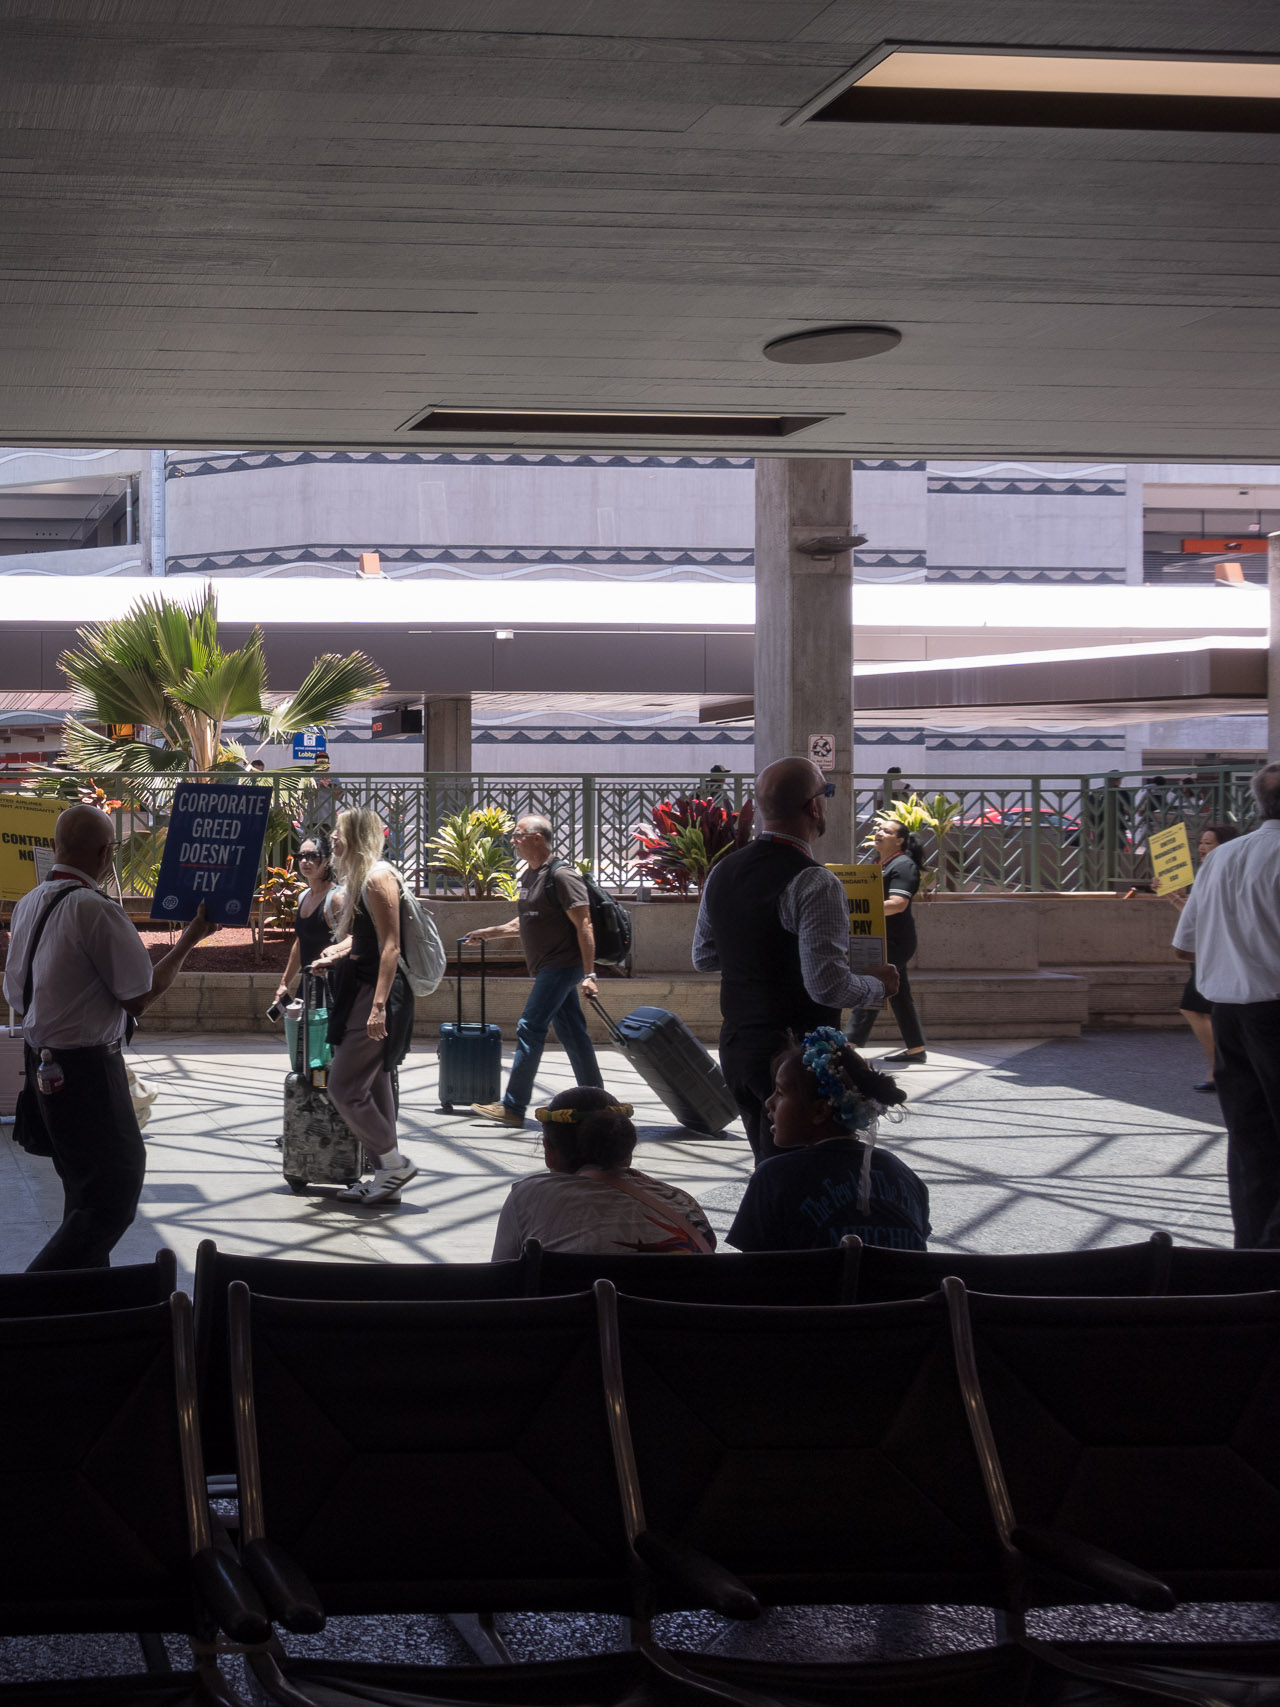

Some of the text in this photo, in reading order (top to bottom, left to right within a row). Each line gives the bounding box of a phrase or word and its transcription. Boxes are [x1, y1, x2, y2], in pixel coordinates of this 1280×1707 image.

[14, 805, 56, 814] ATTENDANTS
[178, 792, 266, 815] CORPORATE
[192, 817, 241, 840] GREED
[18, 849, 34, 861] NO
[179, 842, 245, 865] DOESN'T
[192, 871, 221, 892] FLY
[853, 920, 873, 936] PAY
